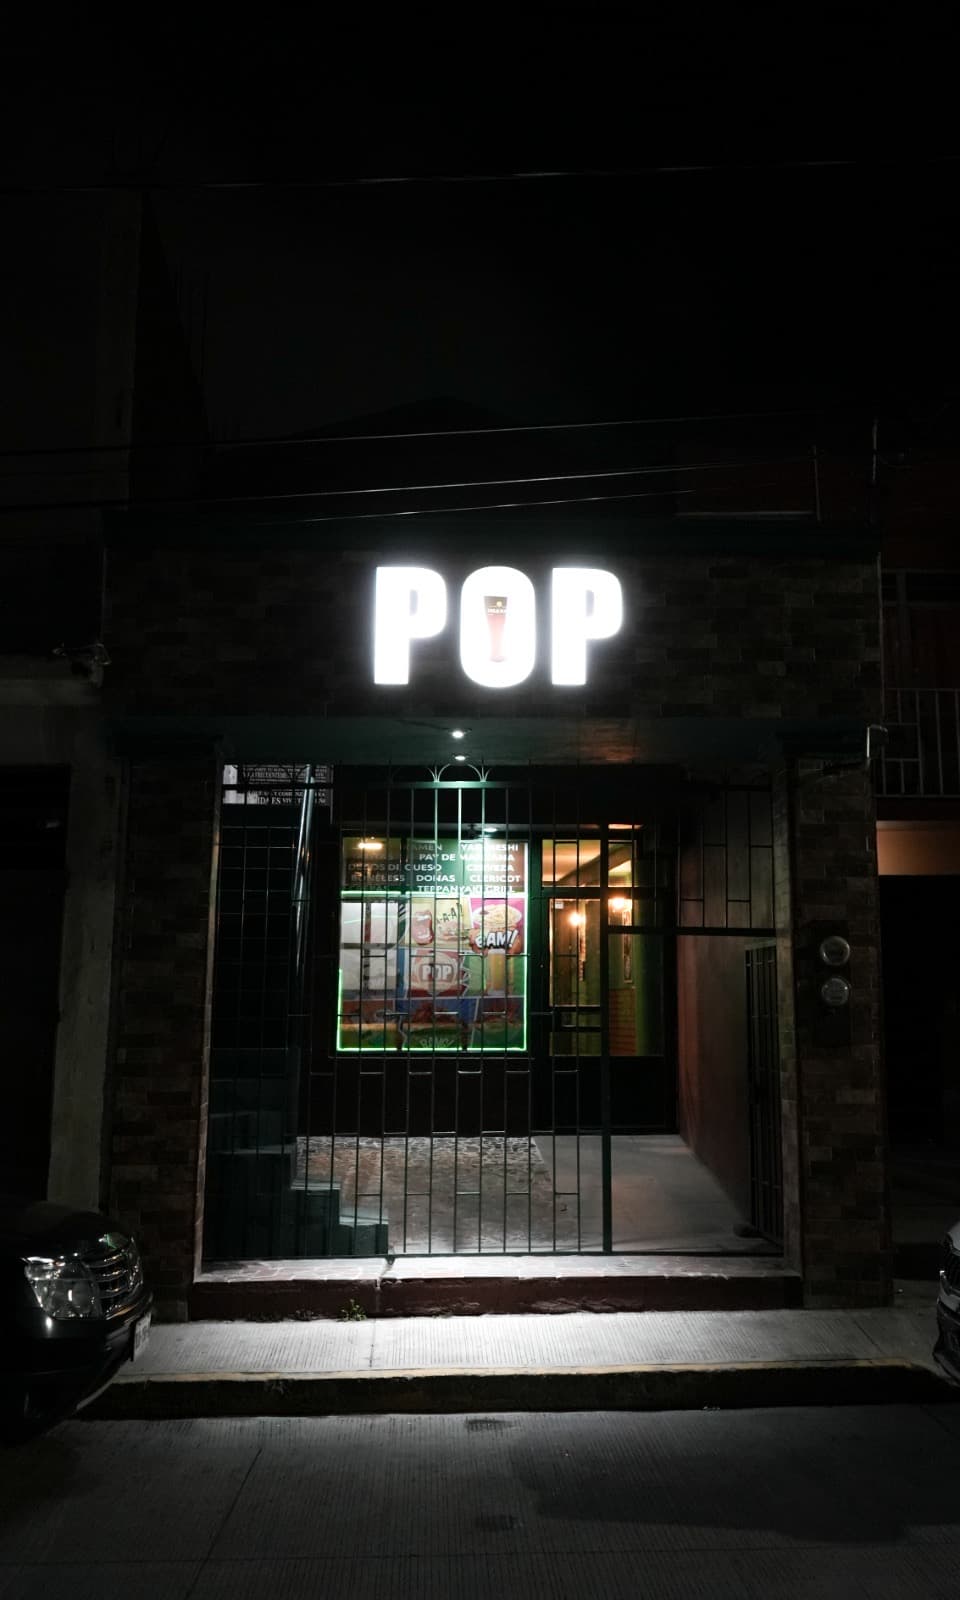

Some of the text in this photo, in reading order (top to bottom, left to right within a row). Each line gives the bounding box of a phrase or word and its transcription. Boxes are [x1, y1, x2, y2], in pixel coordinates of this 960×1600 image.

[374, 566, 624, 688] POP
[460, 843, 519, 851] YAESHI
[418, 853, 515, 861] PAY DE MANA
[350, 873, 406, 882] BNELESS
[416, 874, 456, 882] DONAS
